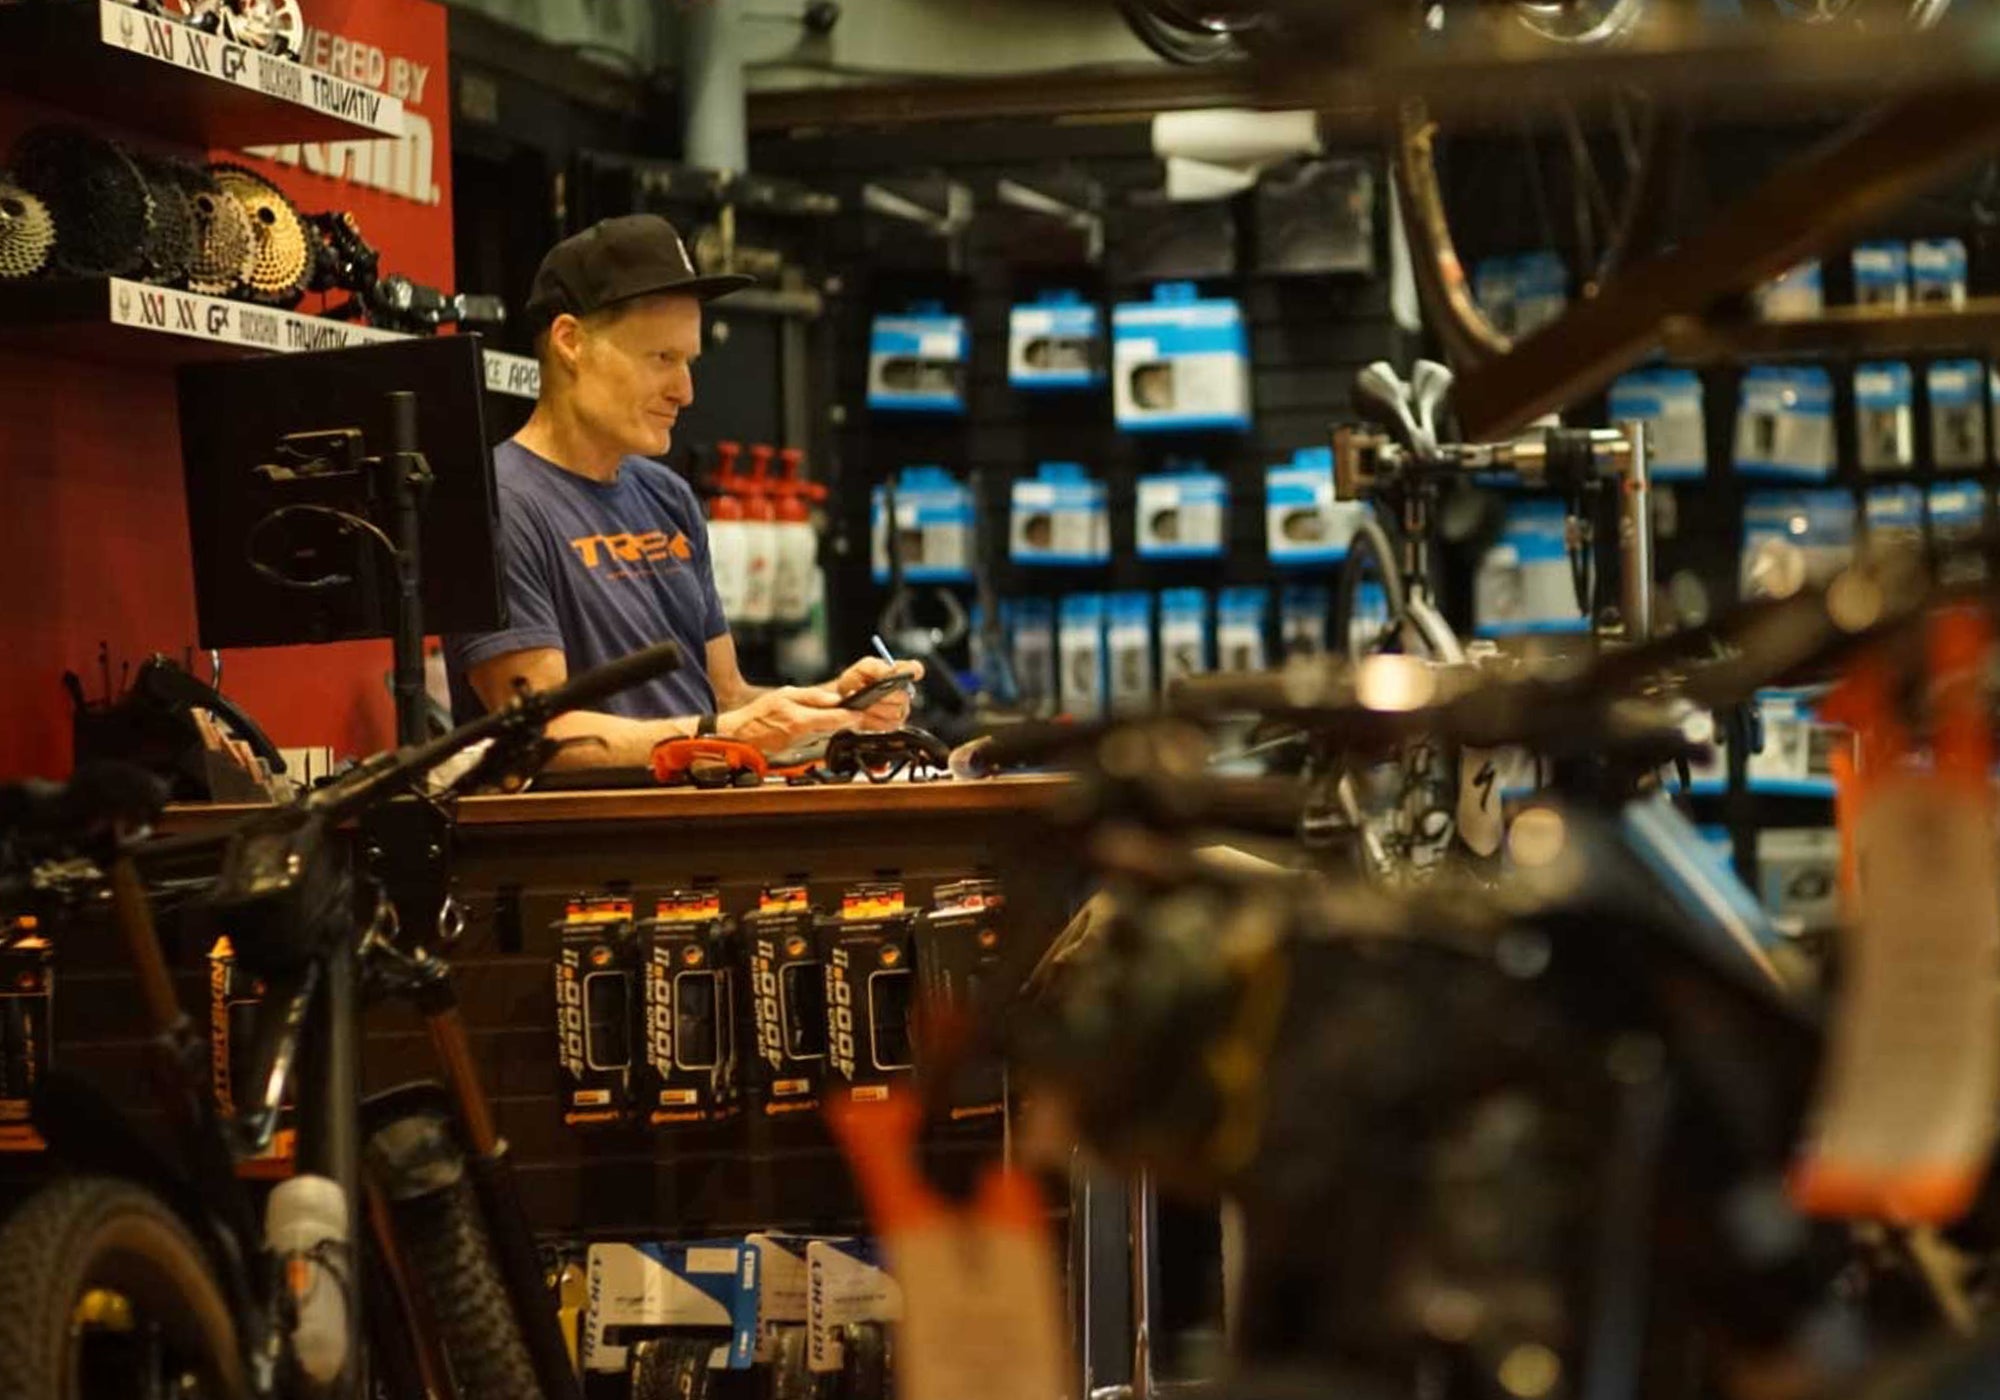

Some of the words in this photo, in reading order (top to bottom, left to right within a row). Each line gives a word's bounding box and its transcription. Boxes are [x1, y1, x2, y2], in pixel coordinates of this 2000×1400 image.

[301, 25, 385, 88] ERED
[388, 56, 430, 104] BY
[310, 73, 380, 125] TRUVATIV
[507, 362, 539, 392] APE
[585, 1256, 601, 1358] RITCHEY
[811, 1258, 824, 1361] RITCHEY
